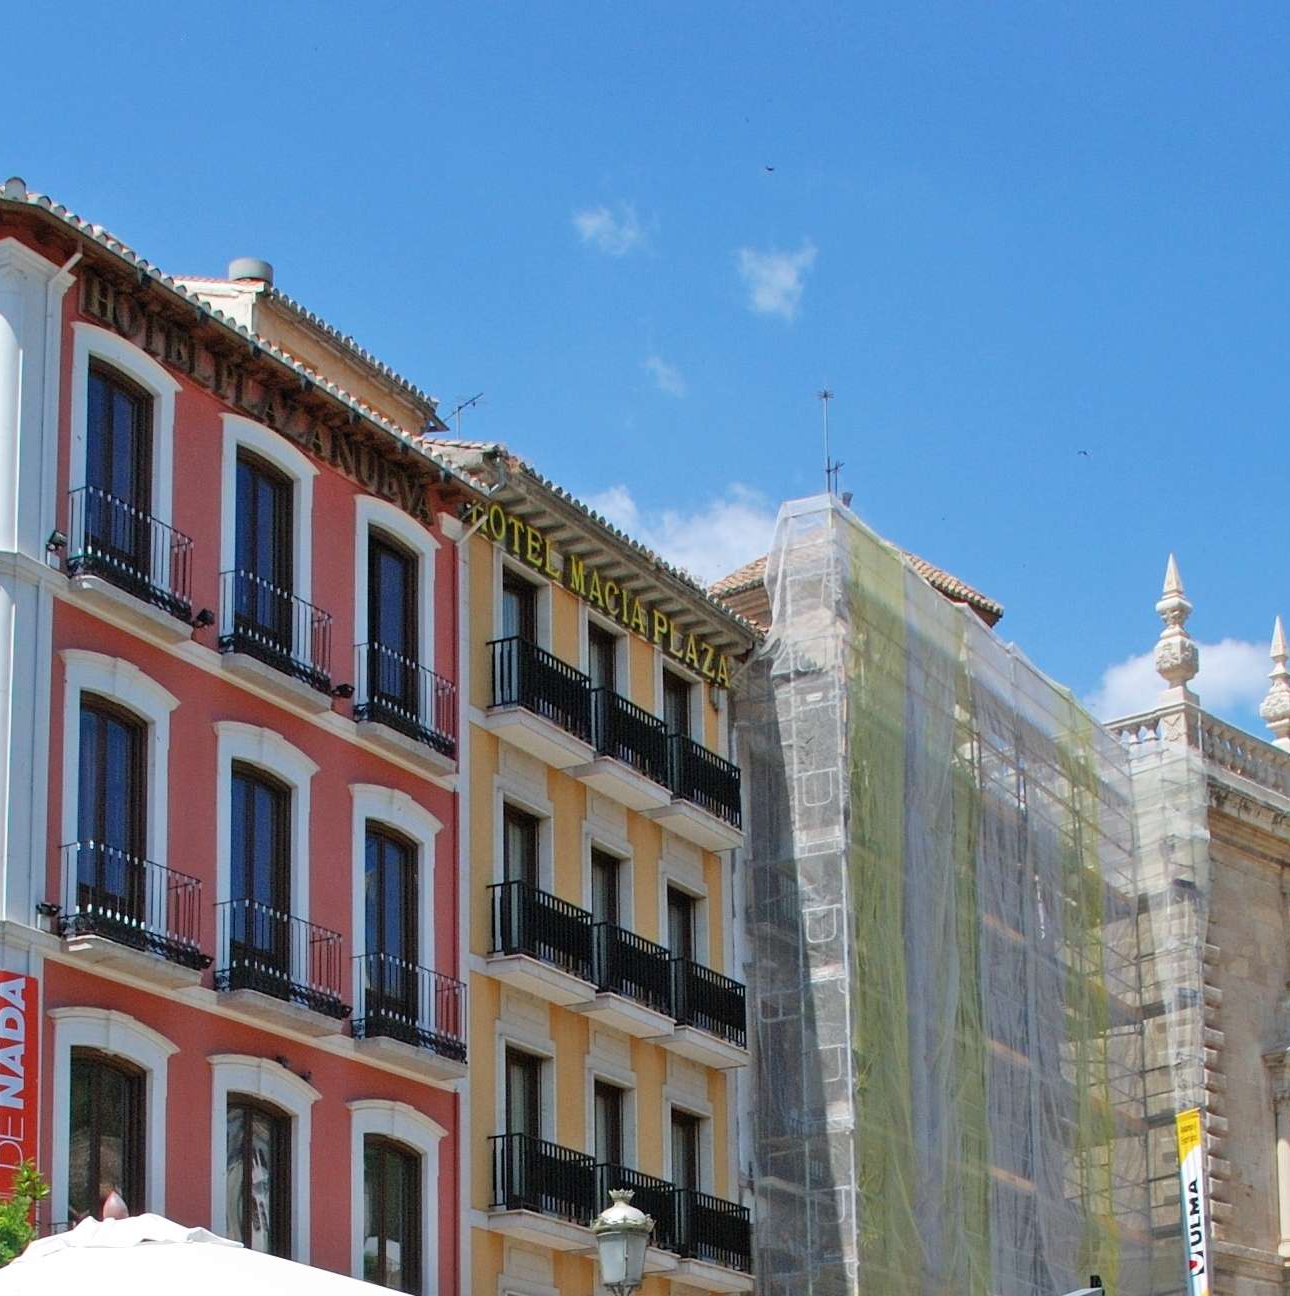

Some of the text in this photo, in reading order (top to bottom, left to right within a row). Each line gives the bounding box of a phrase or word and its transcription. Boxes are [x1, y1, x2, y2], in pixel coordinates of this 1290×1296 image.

[88, 272, 435, 528] HOTEL PLAZA NUEVA
[570, 555, 649, 634] MACIA
[653, 606, 731, 688] PLAZA
[1189, 1178, 1203, 1247] ULMA
